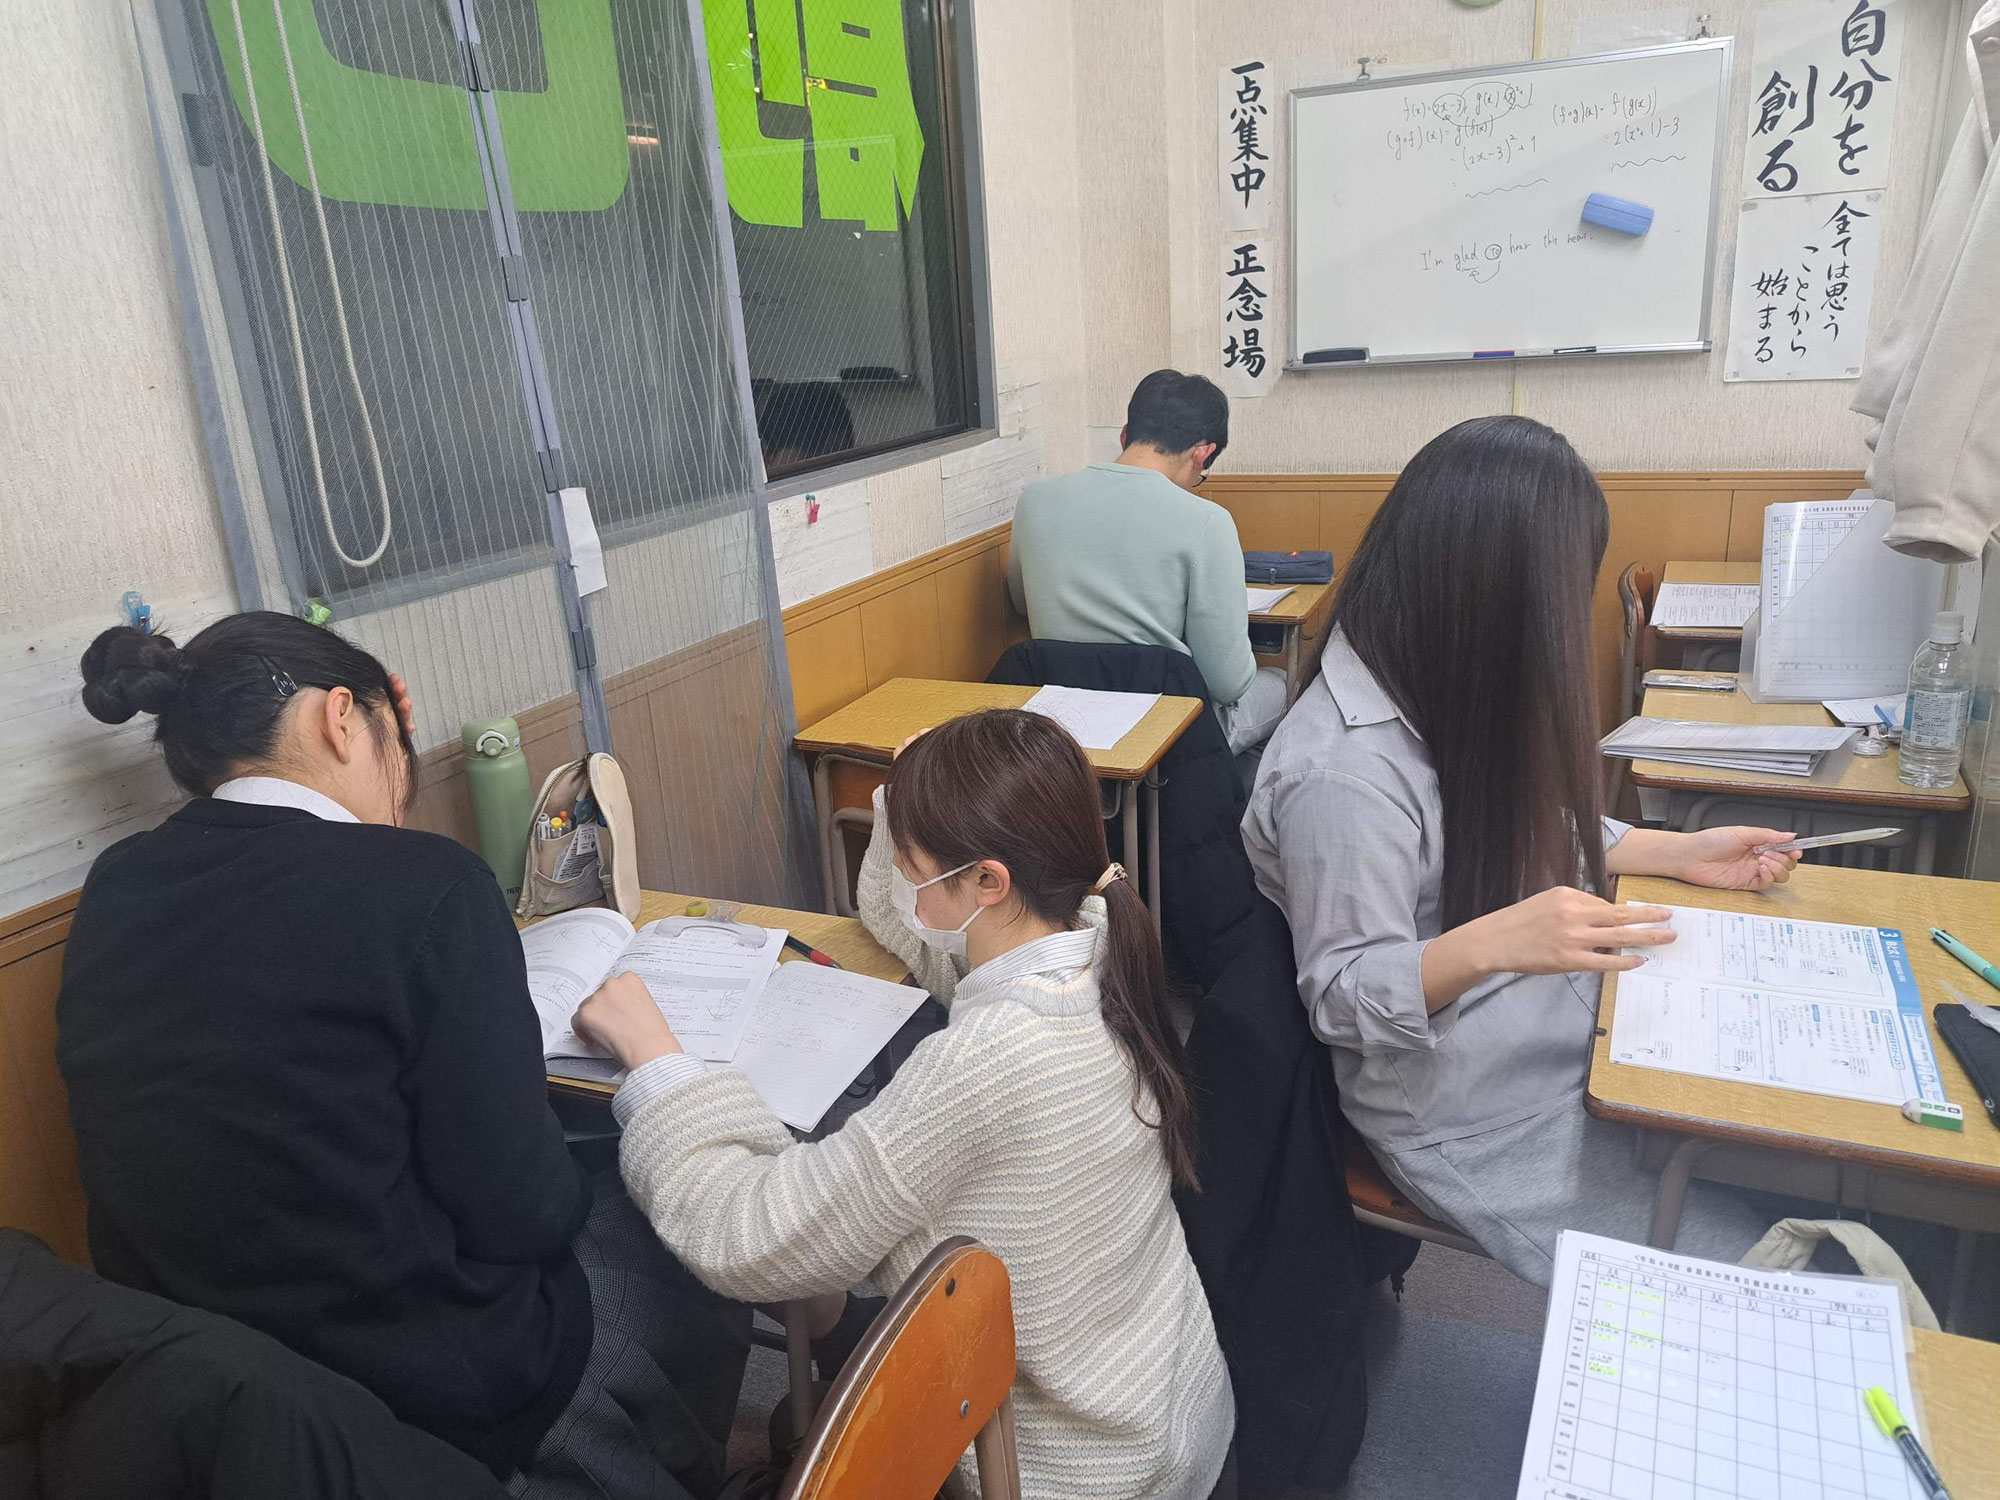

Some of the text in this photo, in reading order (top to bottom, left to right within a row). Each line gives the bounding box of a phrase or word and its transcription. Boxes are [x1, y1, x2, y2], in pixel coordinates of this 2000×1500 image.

[1230, 61, 1269, 210] 一点集中
[1752, 65, 1818, 192] 創る
[1829, 0, 1892, 175] 自分を
[1223, 244, 1268, 378] 正念場
[1454, 243, 1479, 271] glad
[1751, 268, 1789, 363] 始まる
[1787, 245, 1820, 359] ことから
[1821, 200, 1872, 342] 全ては思う
